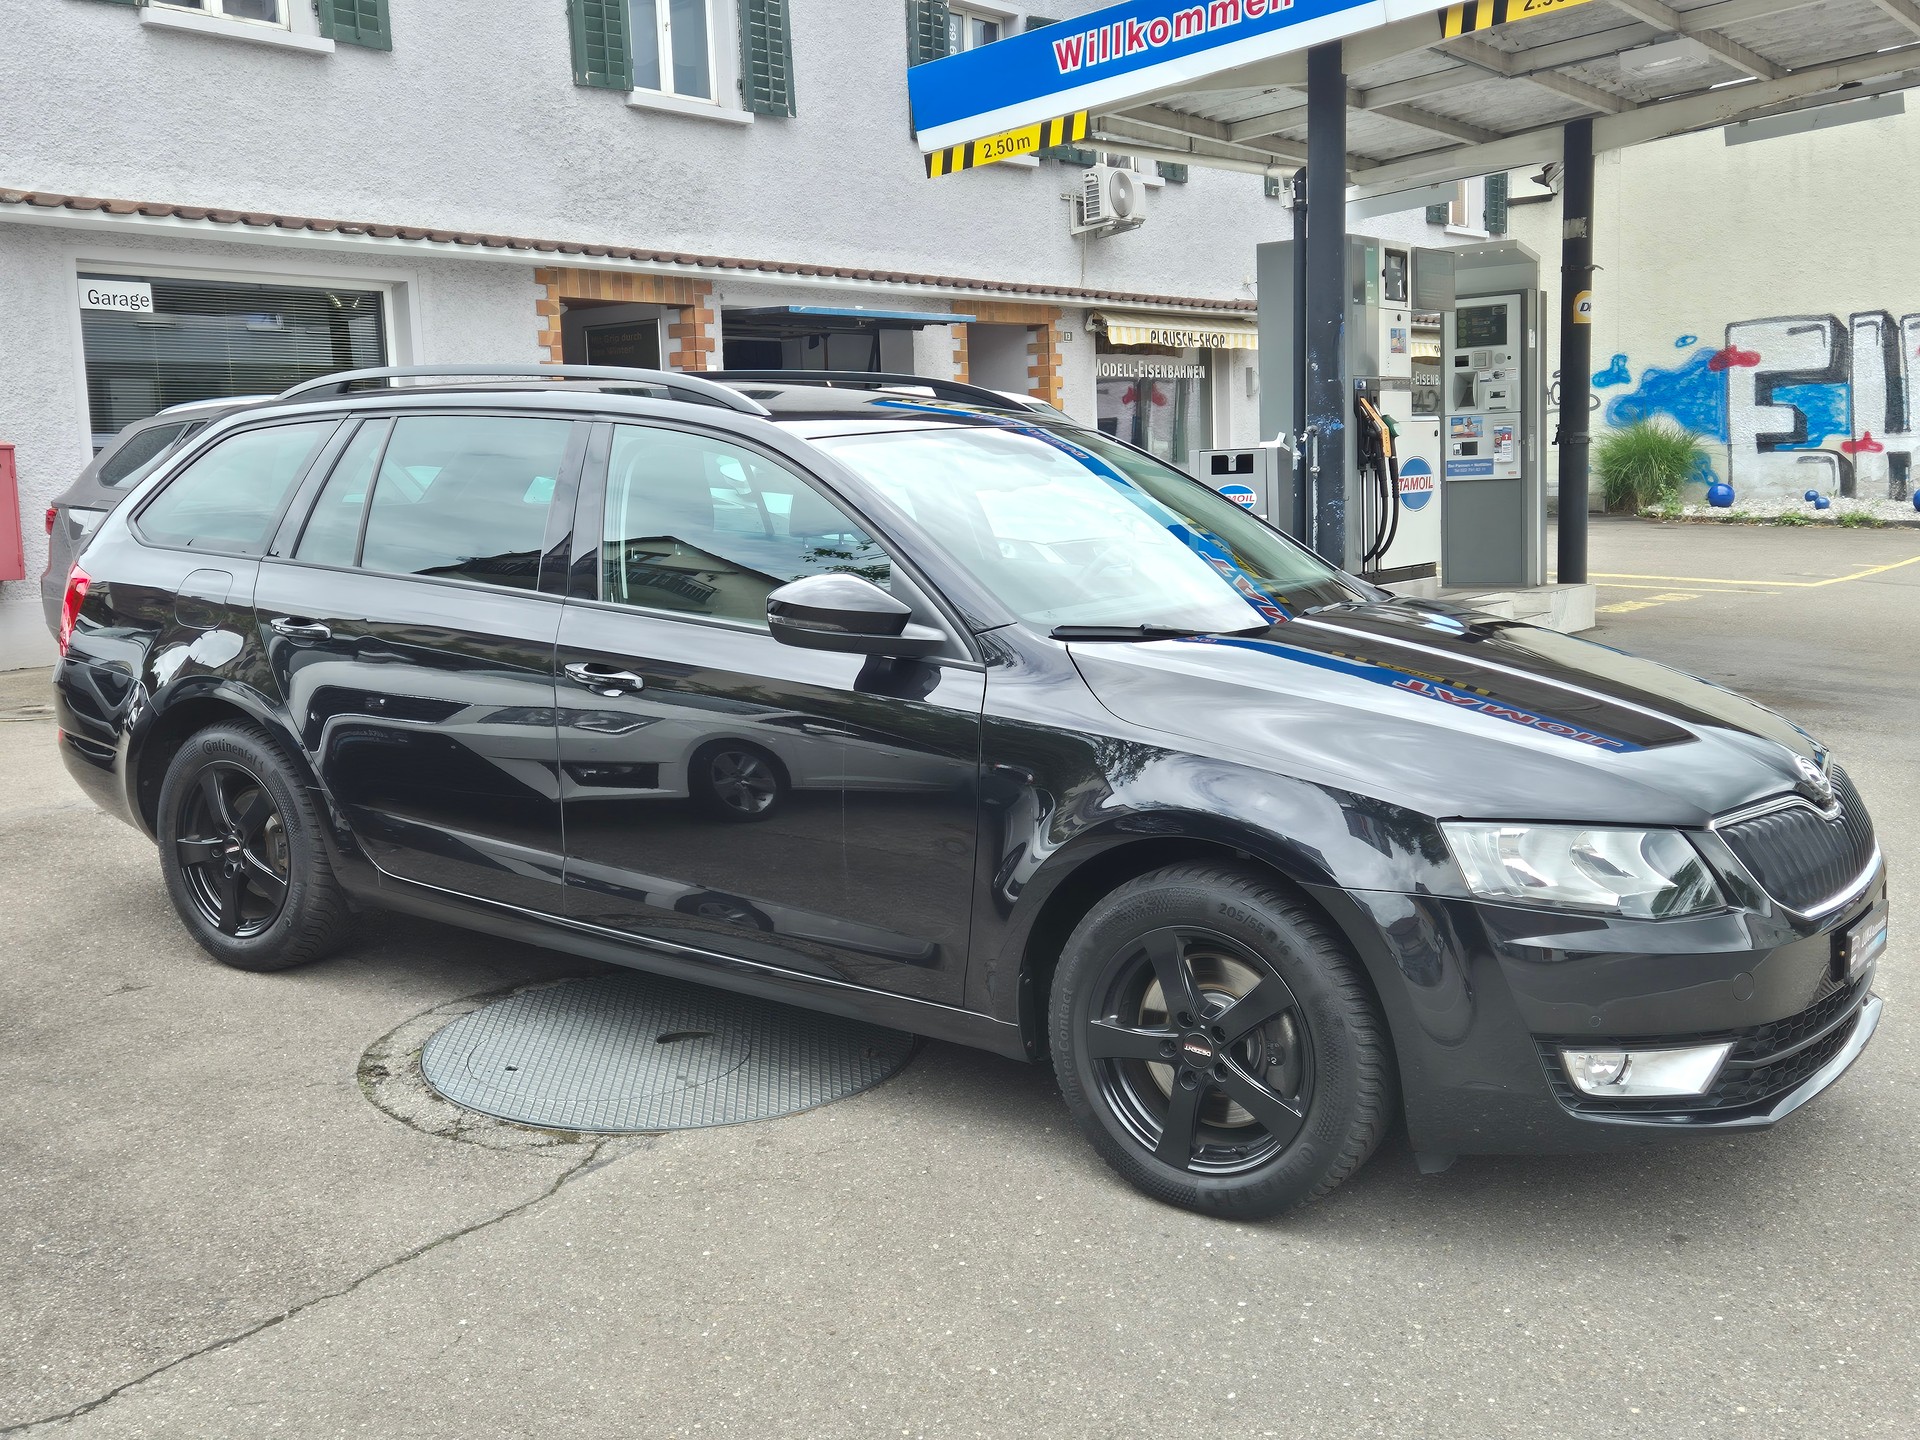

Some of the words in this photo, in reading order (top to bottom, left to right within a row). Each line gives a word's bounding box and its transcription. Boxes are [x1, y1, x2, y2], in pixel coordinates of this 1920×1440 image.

[87, 289, 150, 311] Garage
[621, 331, 642, 342] durch
[1399, 476, 1434, 491] TAMOIL
[1227, 494, 1255, 504] MOIL
[203, 738, 258, 767] Continental
[1218, 903, 1265, 934] 205/55
